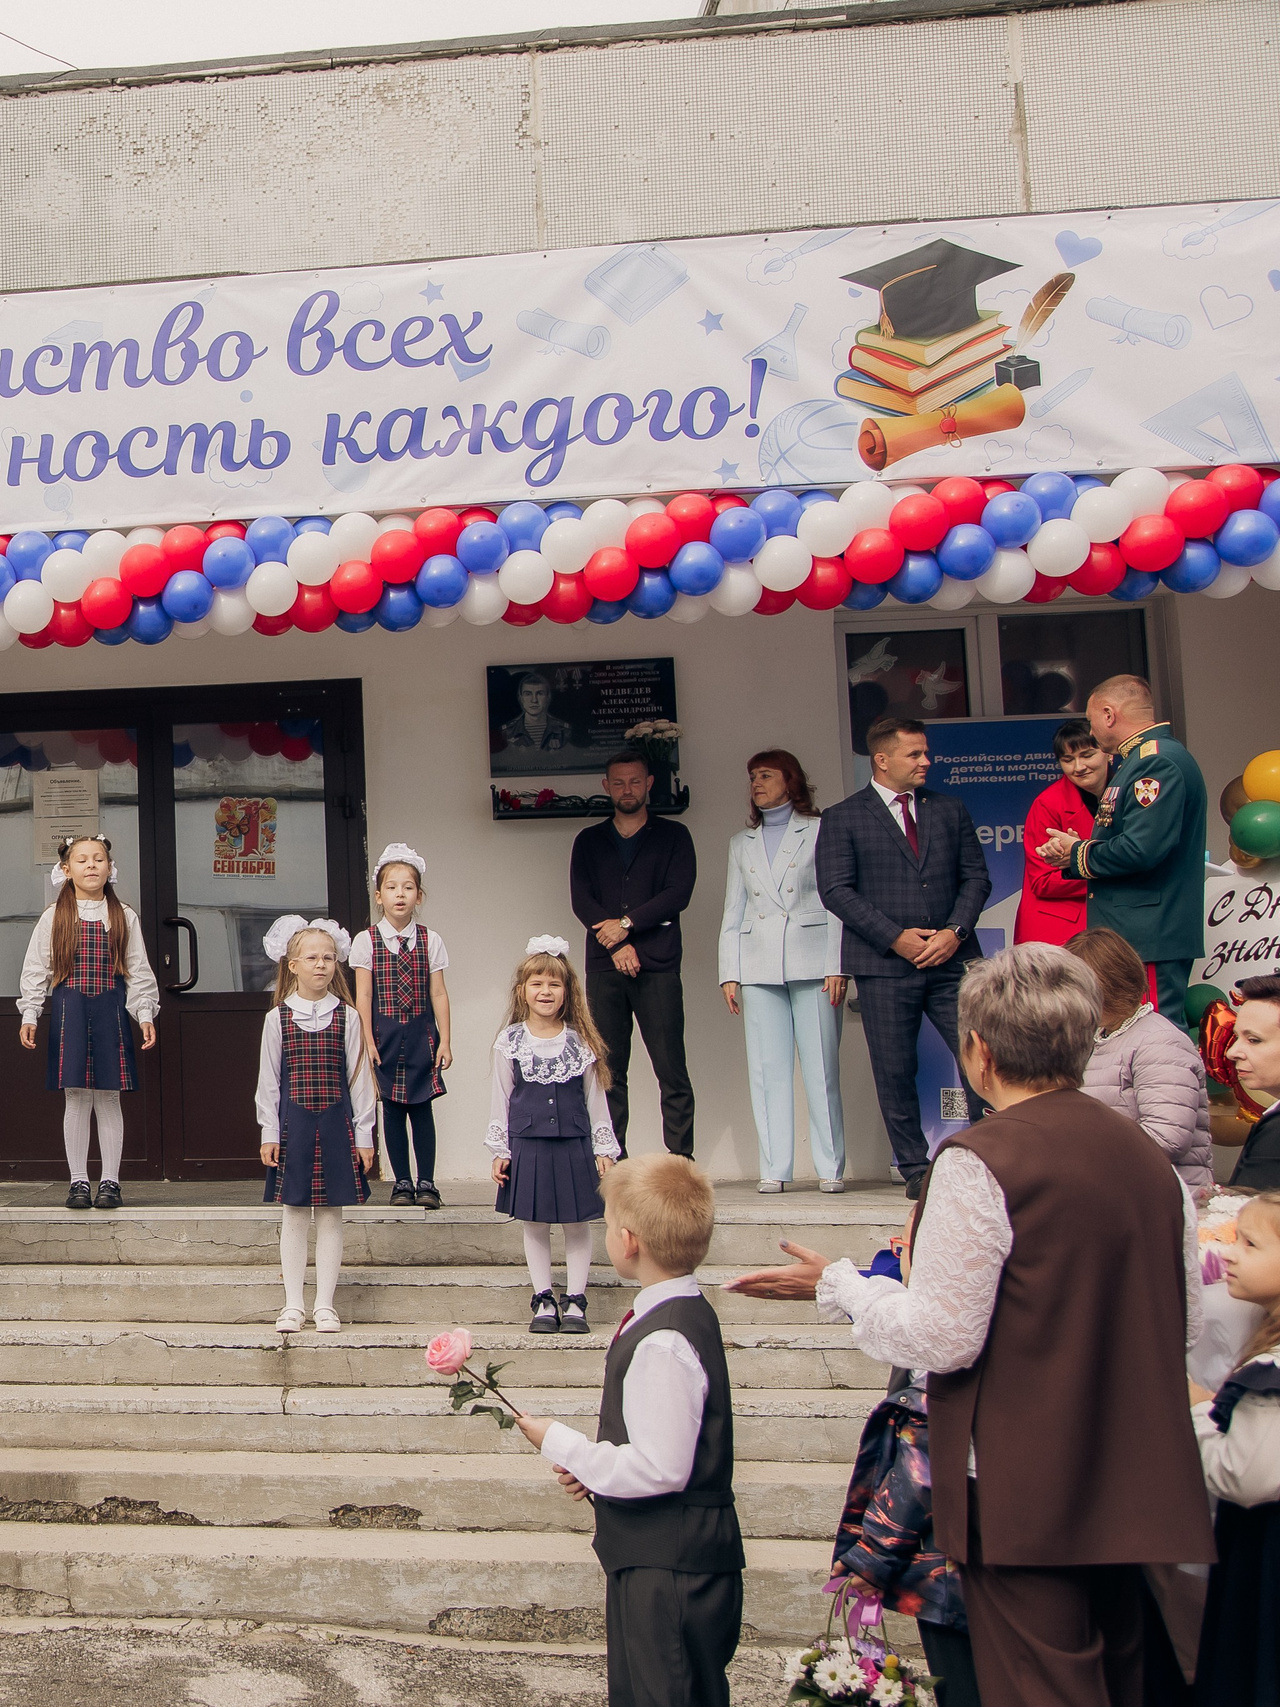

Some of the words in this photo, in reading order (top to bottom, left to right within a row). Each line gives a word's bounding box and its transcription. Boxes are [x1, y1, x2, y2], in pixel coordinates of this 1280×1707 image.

[286, 290, 494, 378] всех
[321, 358, 769, 487] каждого!
[600, 687, 651, 696] МЕДВЕДЕВ
[602, 697, 651, 705] АЛЕКСАНДР
[591, 705, 663, 715] АЛЕКСАНДРОВИЧ
[934, 753, 1022, 764] Российское
[950, 764, 993, 774] детей
[943, 774, 1026, 785] «Движение
[213, 860, 275, 874] СЕНТЯБРЯ!
